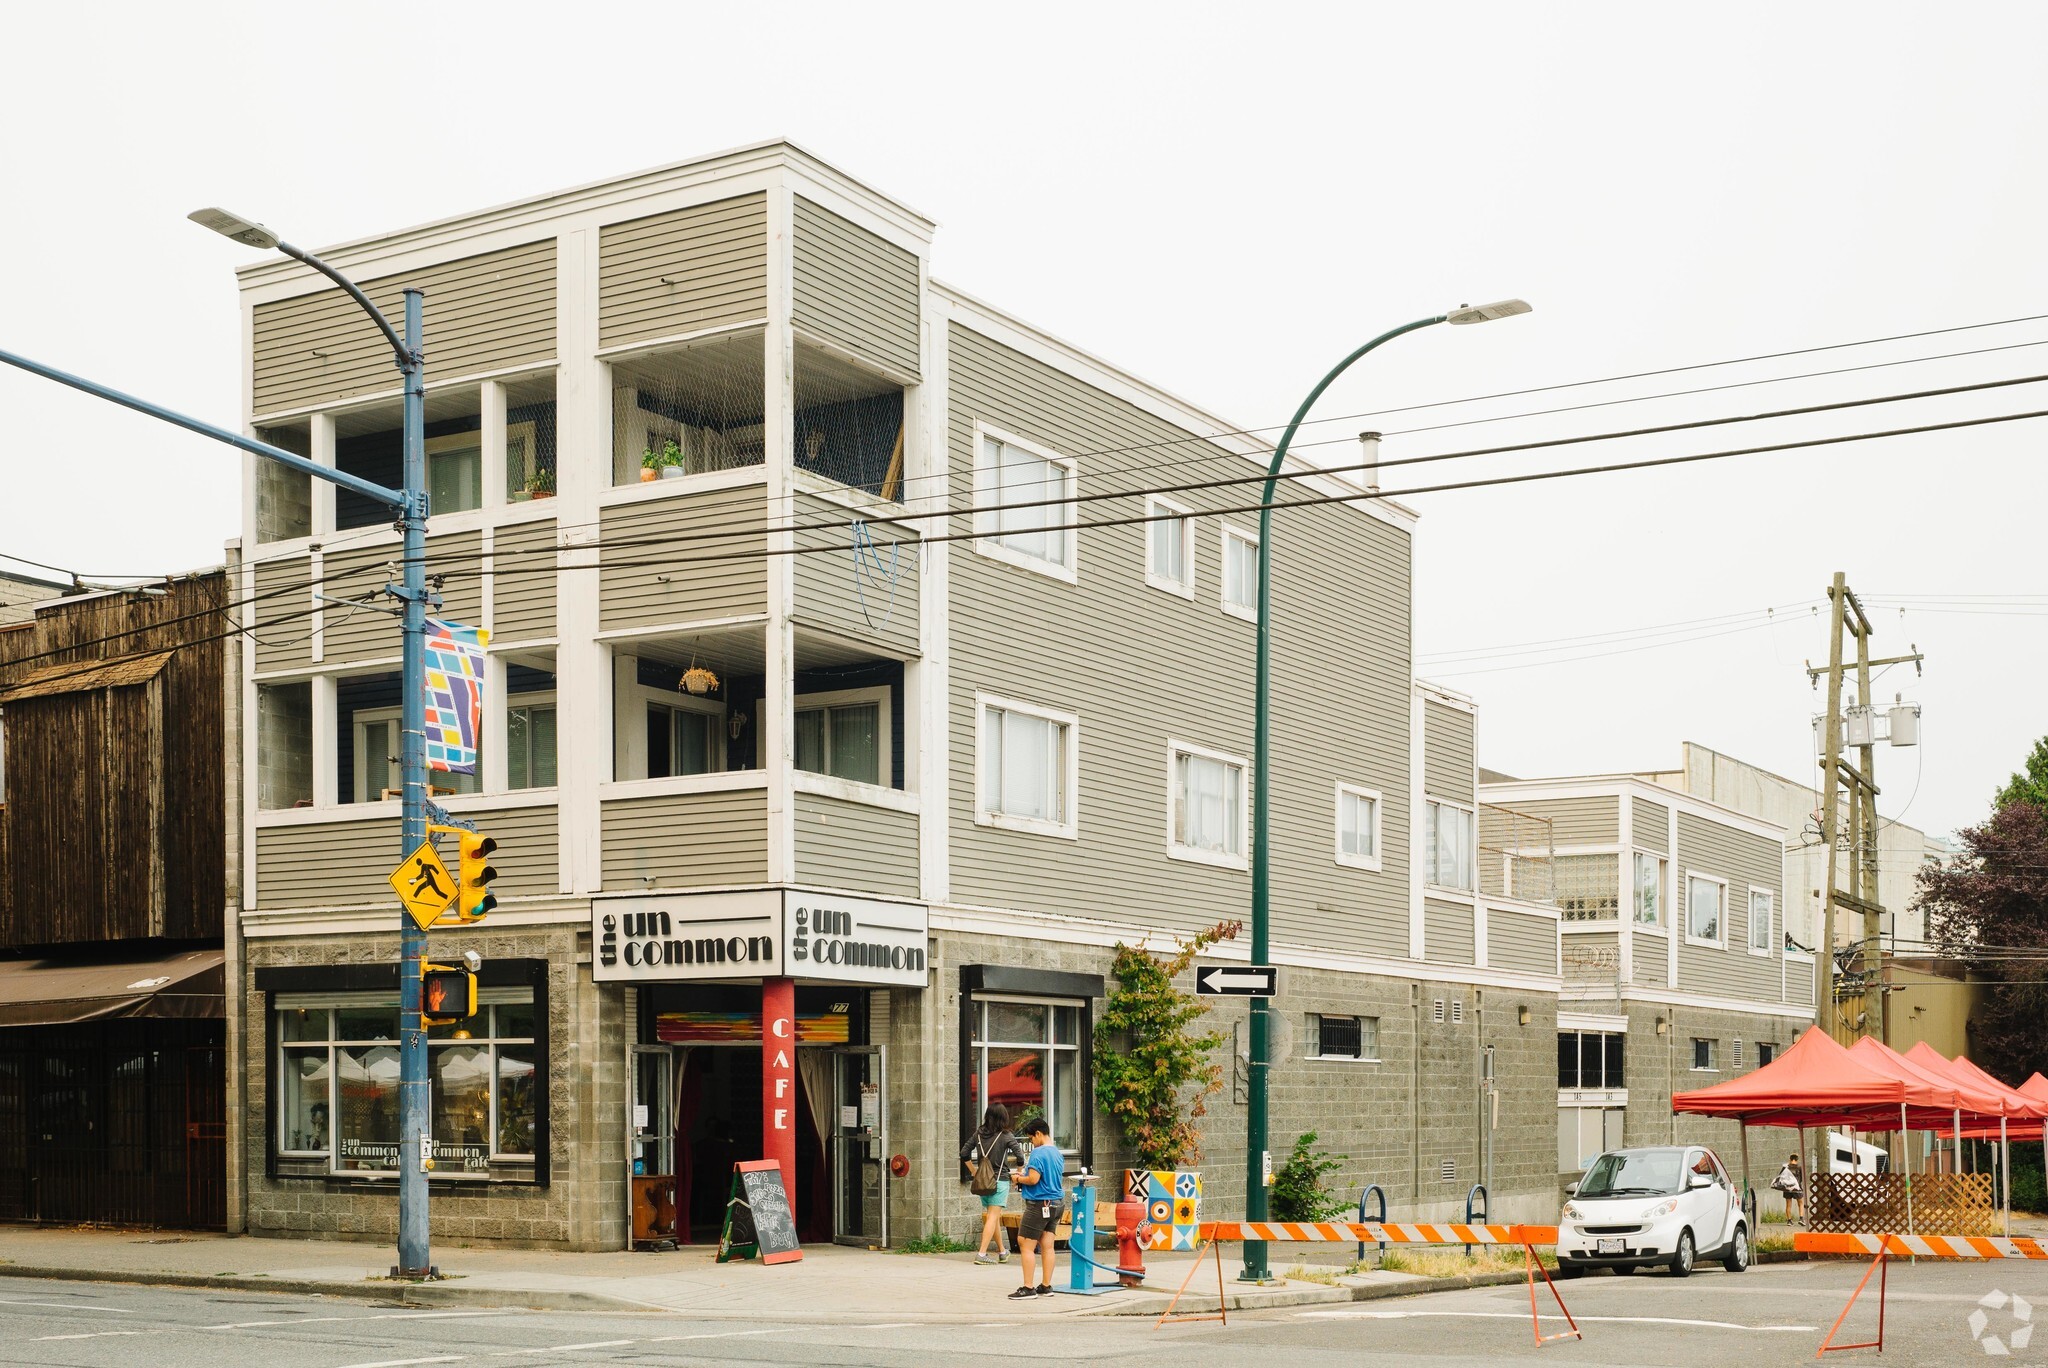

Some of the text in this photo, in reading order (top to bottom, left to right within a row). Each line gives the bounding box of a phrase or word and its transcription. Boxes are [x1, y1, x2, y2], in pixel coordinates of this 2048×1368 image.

[623, 910, 672, 937] un
[793, 907, 808, 962] the
[812, 908, 852, 936] un
[600, 914, 617, 968] the
[623, 936, 773, 967] common
[812, 937, 924, 971] common
[772, 1018, 789, 1130] CAFE
[347, 1138, 360, 1146] un
[347, 1146, 398, 1156] common
[429, 1147, 480, 1158] ommon
